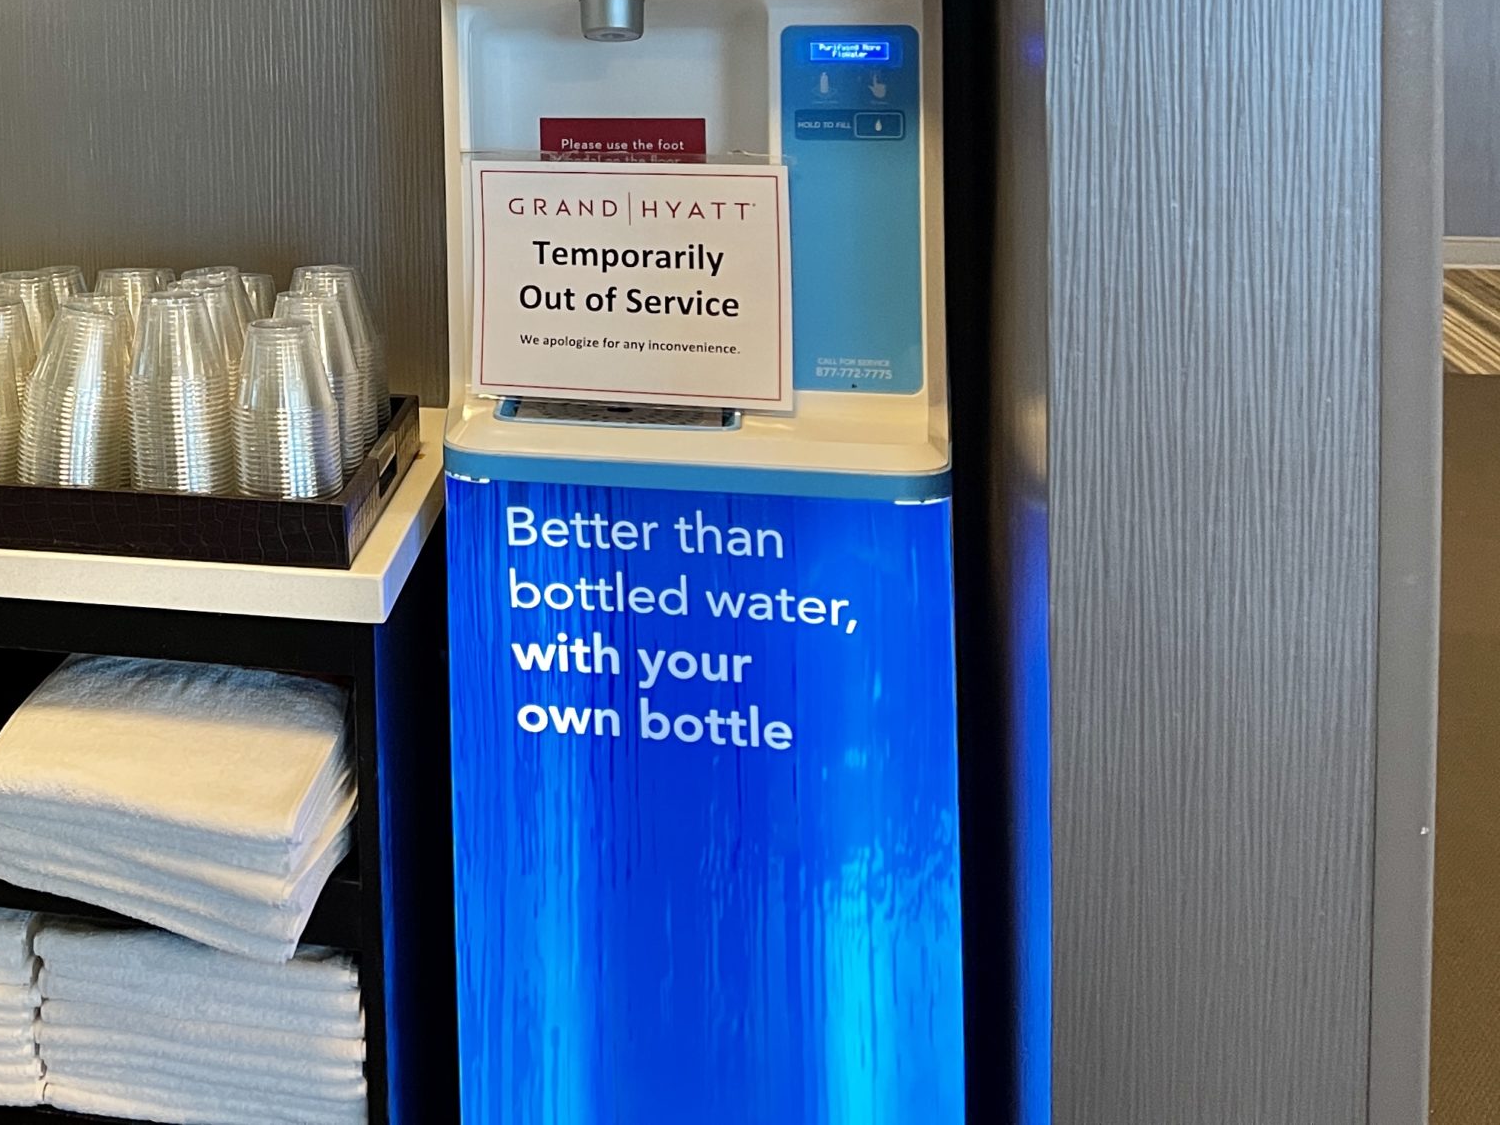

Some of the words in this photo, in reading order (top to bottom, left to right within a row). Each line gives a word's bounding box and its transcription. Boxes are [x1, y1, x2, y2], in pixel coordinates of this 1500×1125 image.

[797, 121, 821, 129] HOLD
[823, 121, 834, 129] TO
[835, 121, 852, 129] FILL
[561, 138, 602, 150] Please
[606, 141, 628, 150] use
[633, 139, 654, 150] the
[658, 138, 684, 151] foot
[508, 197, 618, 217] GRAND
[641, 200, 751, 220] HYATT
[532, 240, 724, 277] Temporarily
[519, 284, 576, 311] Out
[585, 286, 618, 313] of
[626, 288, 740, 317] Service
[519, 334, 540, 345] We
[543, 336, 599, 349] apologize
[602, 337, 621, 349] for
[623, 341, 645, 353] any
[648, 339, 741, 355] inconvenience.
[505, 506, 659, 551] Better
[674, 510, 785, 559] than
[508, 567, 689, 616] bottled
[705, 588, 859, 635] water,
[511, 632, 621, 675] with
[636, 647, 753, 690] your
[516, 703, 622, 737] own
[639, 697, 794, 751] bottle
